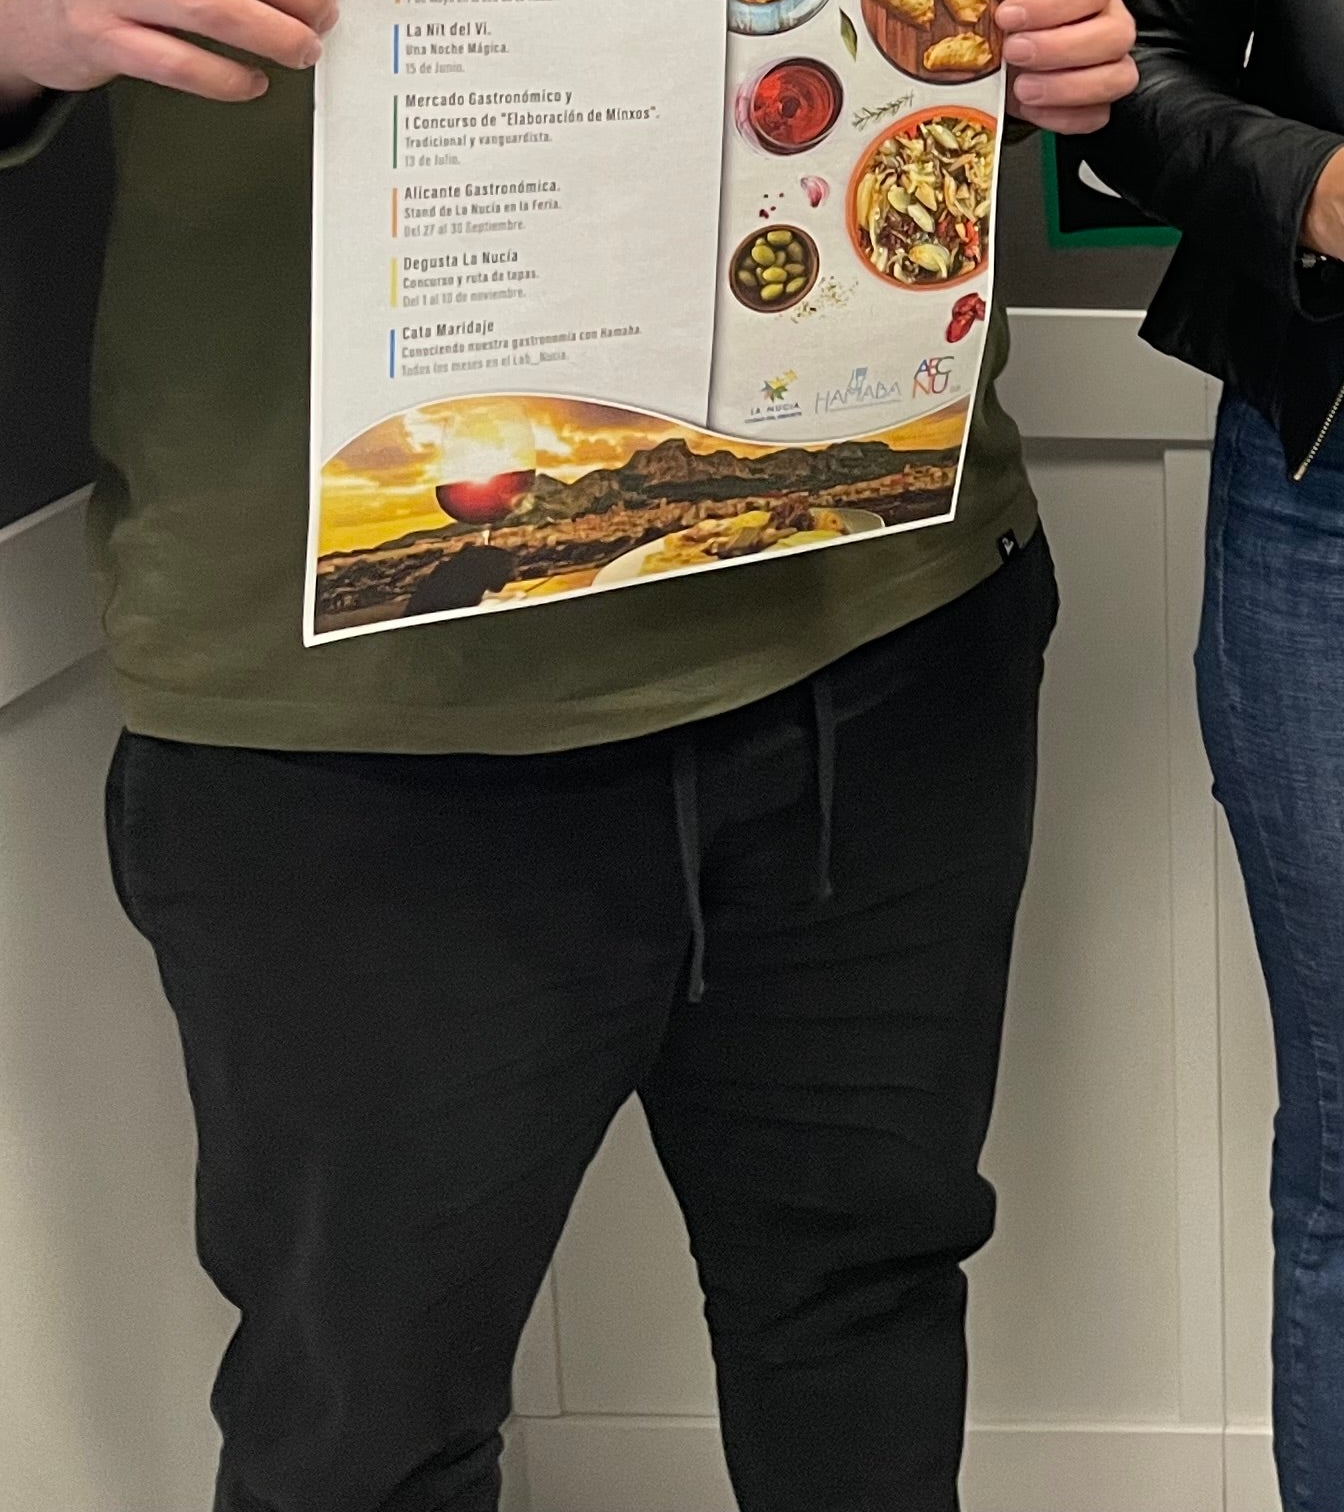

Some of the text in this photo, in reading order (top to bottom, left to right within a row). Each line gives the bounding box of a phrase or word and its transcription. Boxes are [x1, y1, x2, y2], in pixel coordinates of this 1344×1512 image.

[406, 24, 421, 37] La
[450, 22, 470, 36] del
[406, 45, 426, 55] Una
[431, 44, 464, 54] Noche
[420, 63, 431, 73] de
[406, 91, 572, 107] Mercado Gastronómico y
[413, 116, 477, 129] Concurso
[481, 115, 496, 127] de
[588, 110, 602, 122] de
[406, 136, 466, 148] Tradicional
[470, 137, 475, 148] y
[419, 155, 431, 166] de
[404, 180, 560, 200] Alicante Gastronómica.
[404, 206, 436, 219] Stand
[440, 206, 452, 216] de
[456, 205, 467, 216] La
[504, 203, 516, 212] en
[403, 250, 518, 272] Degusta La Nucía
[403, 276, 454, 288] Concurso
[457, 276, 462, 286] y
[466, 273, 488, 284] ruta
[492, 272, 503, 282] de
[403, 320, 494, 340] Cata Maridaje
